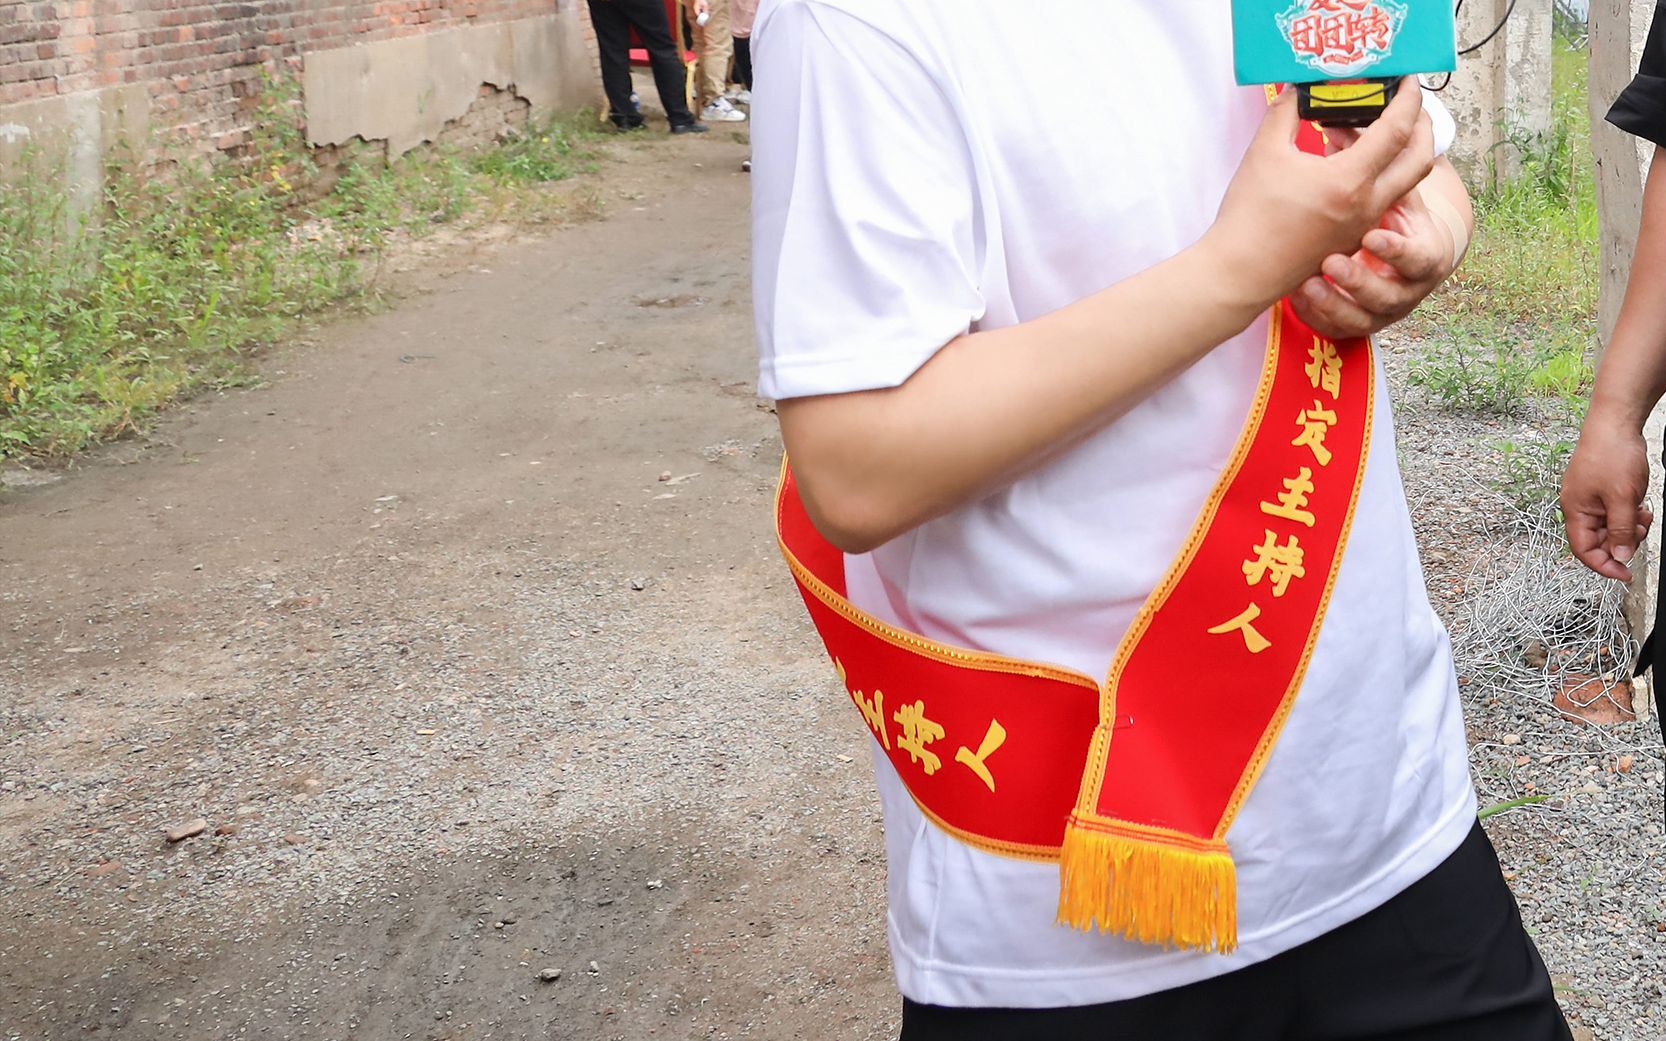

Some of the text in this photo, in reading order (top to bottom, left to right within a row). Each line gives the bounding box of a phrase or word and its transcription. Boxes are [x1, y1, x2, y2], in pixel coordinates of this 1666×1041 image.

[1290, 7, 1389, 56] 团团转
[1207, 334, 1343, 654] 指定主持人
[835, 656, 1007, 793] 主持人
